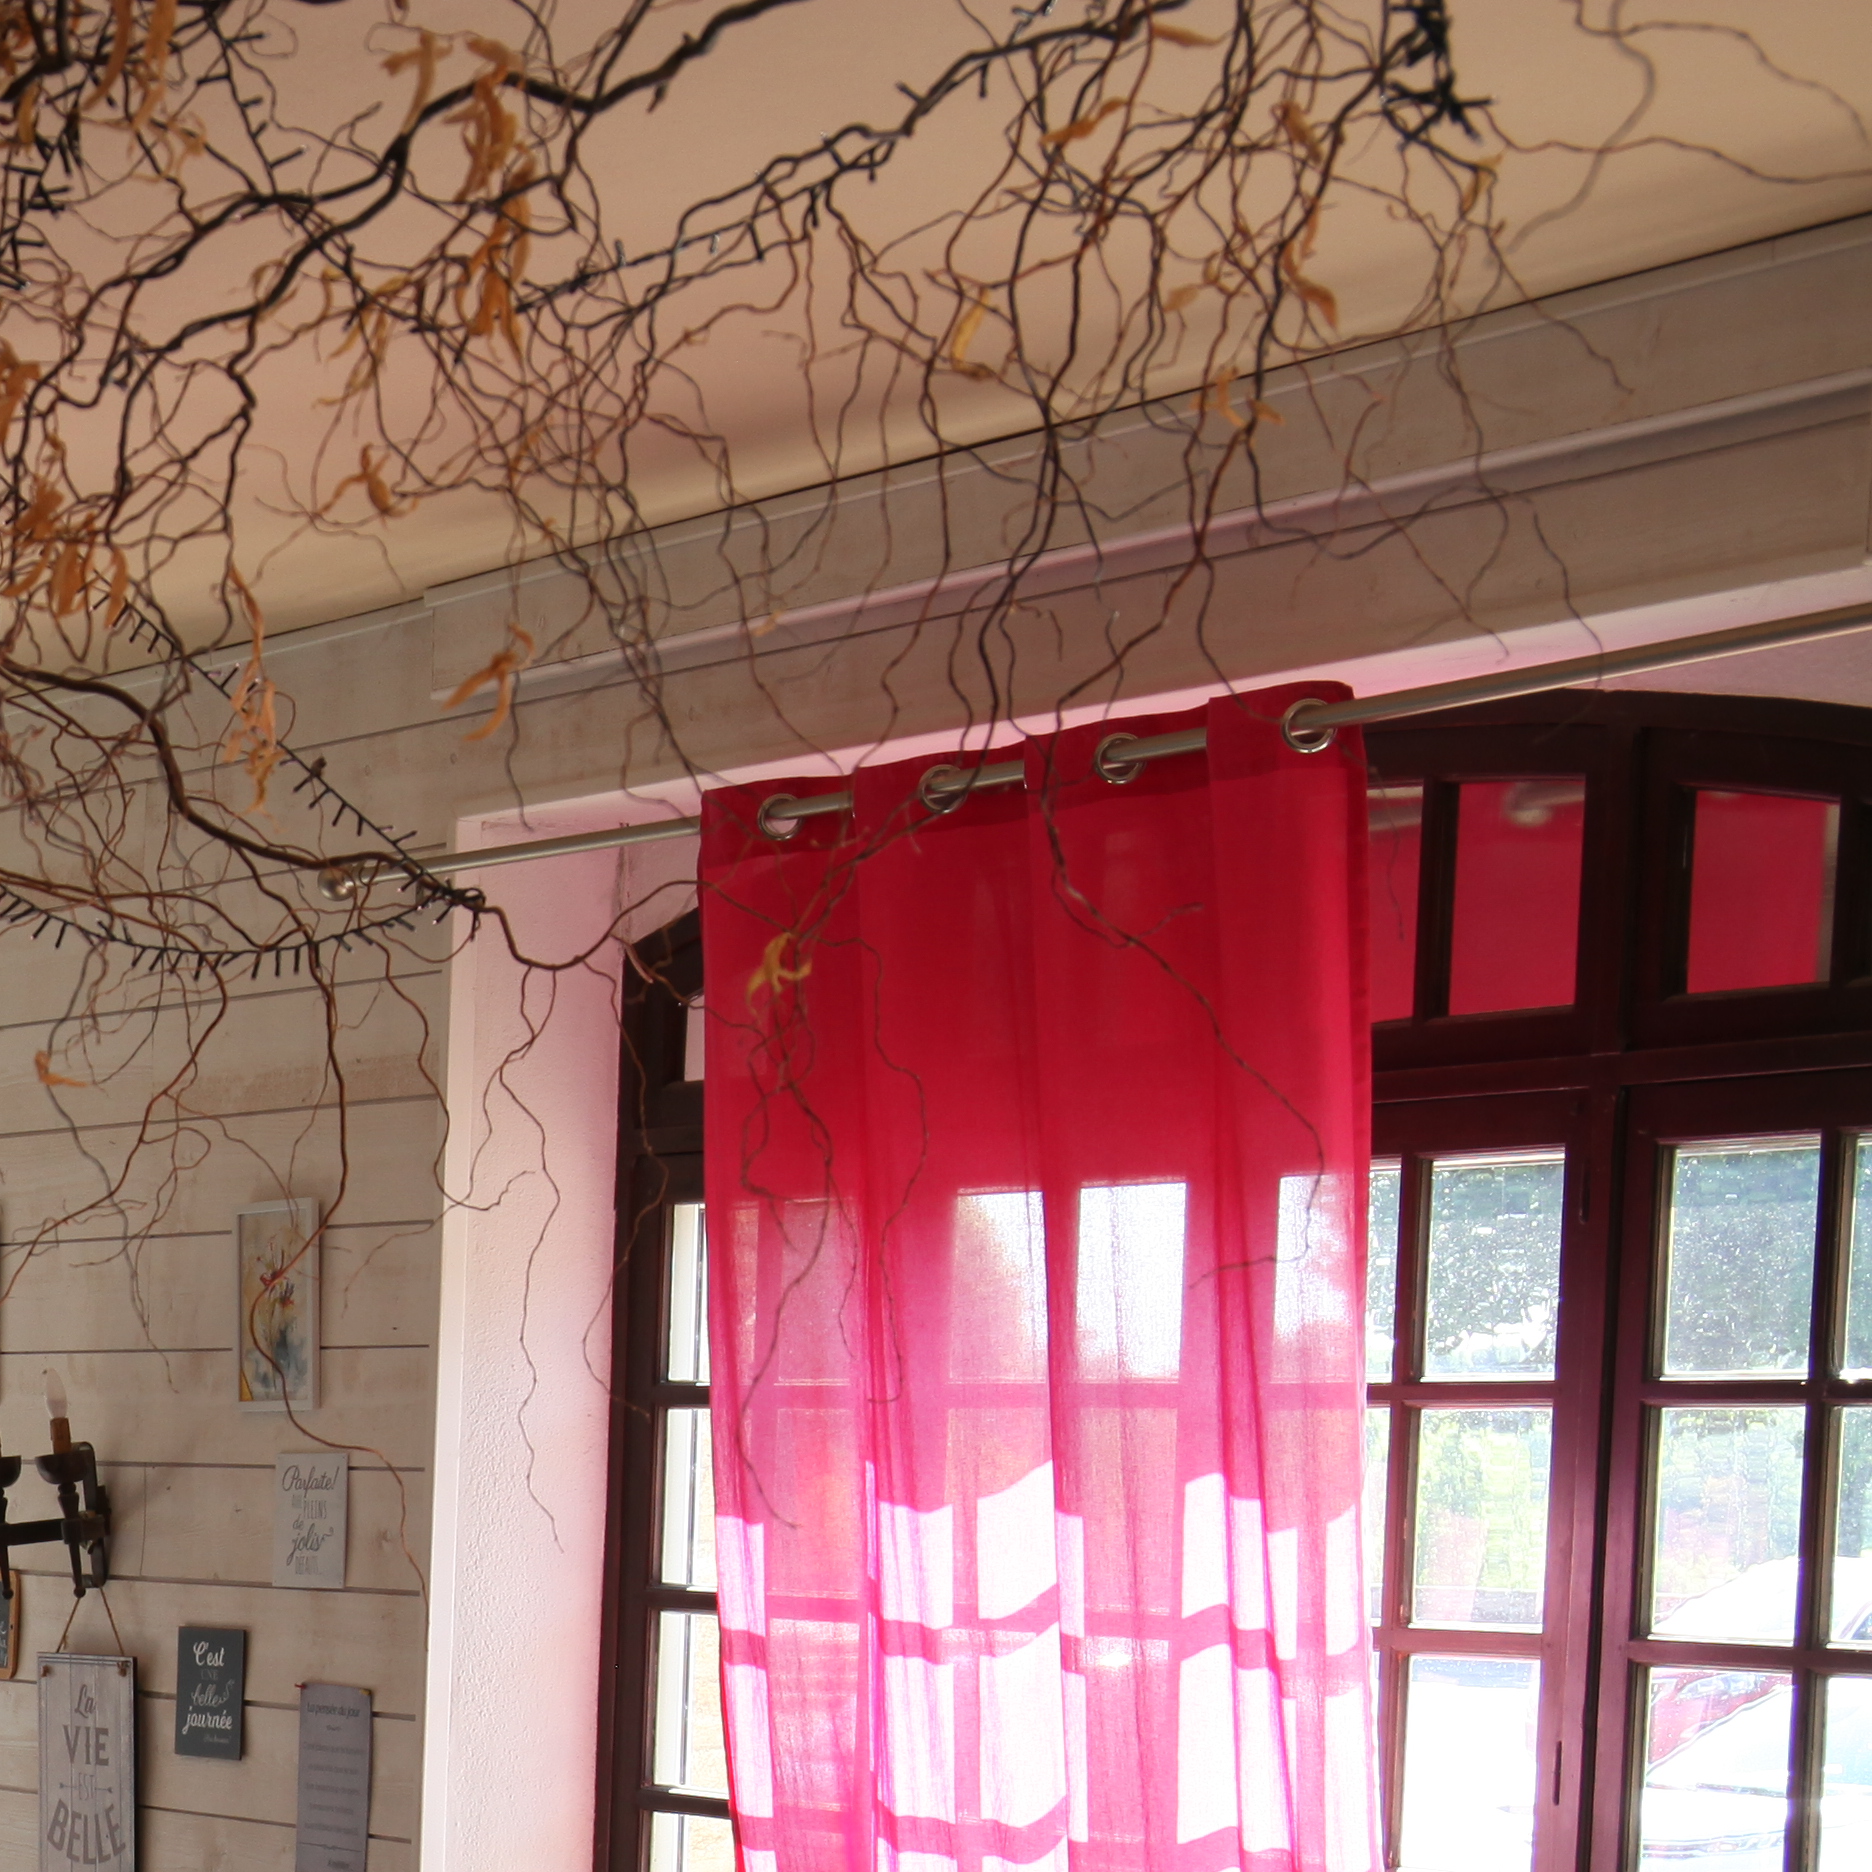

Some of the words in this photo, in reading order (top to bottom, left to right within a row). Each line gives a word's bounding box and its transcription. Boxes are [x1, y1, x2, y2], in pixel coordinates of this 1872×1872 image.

[192, 1640, 225, 1667] C'est
[74, 1684, 97, 1719] La
[182, 1706, 233, 1735] journée
[62, 1724, 110, 1766] VIE
[47, 1799, 127, 1865] BELLE
